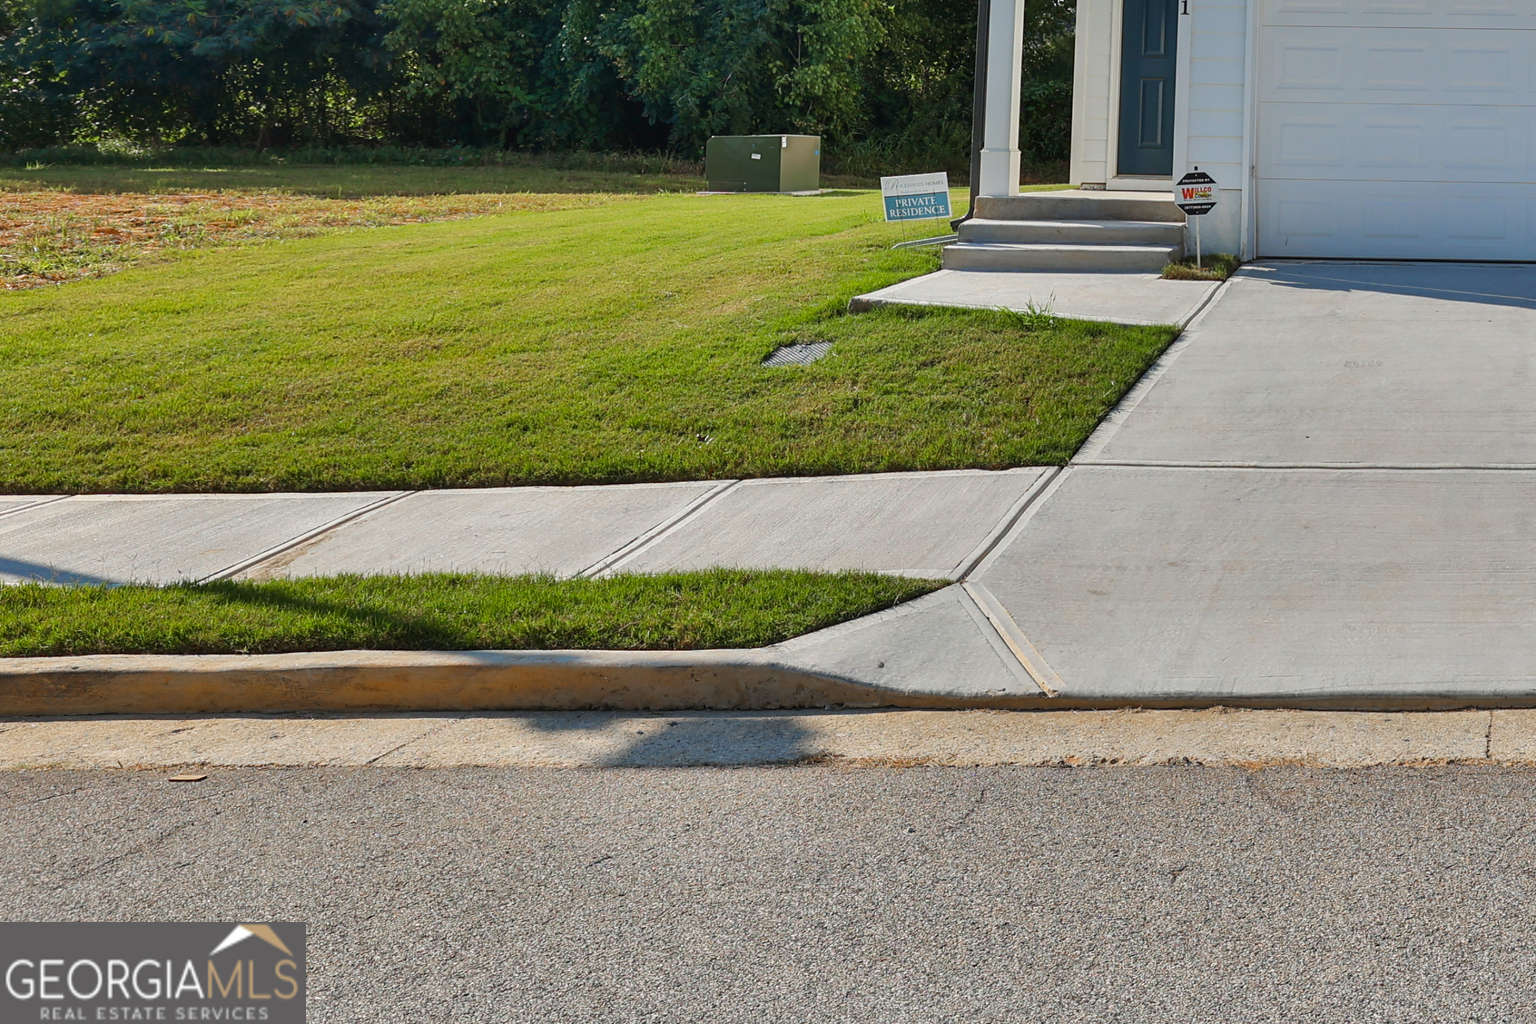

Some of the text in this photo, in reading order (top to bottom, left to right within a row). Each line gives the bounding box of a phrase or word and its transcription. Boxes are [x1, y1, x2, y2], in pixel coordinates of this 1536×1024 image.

[885, 178, 925, 191] ROCKHAVEN
[1182, 187, 1212, 199] WILLCO
[895, 196, 937, 207] PRIVATE
[890, 205, 945, 217] RESIDENCE
